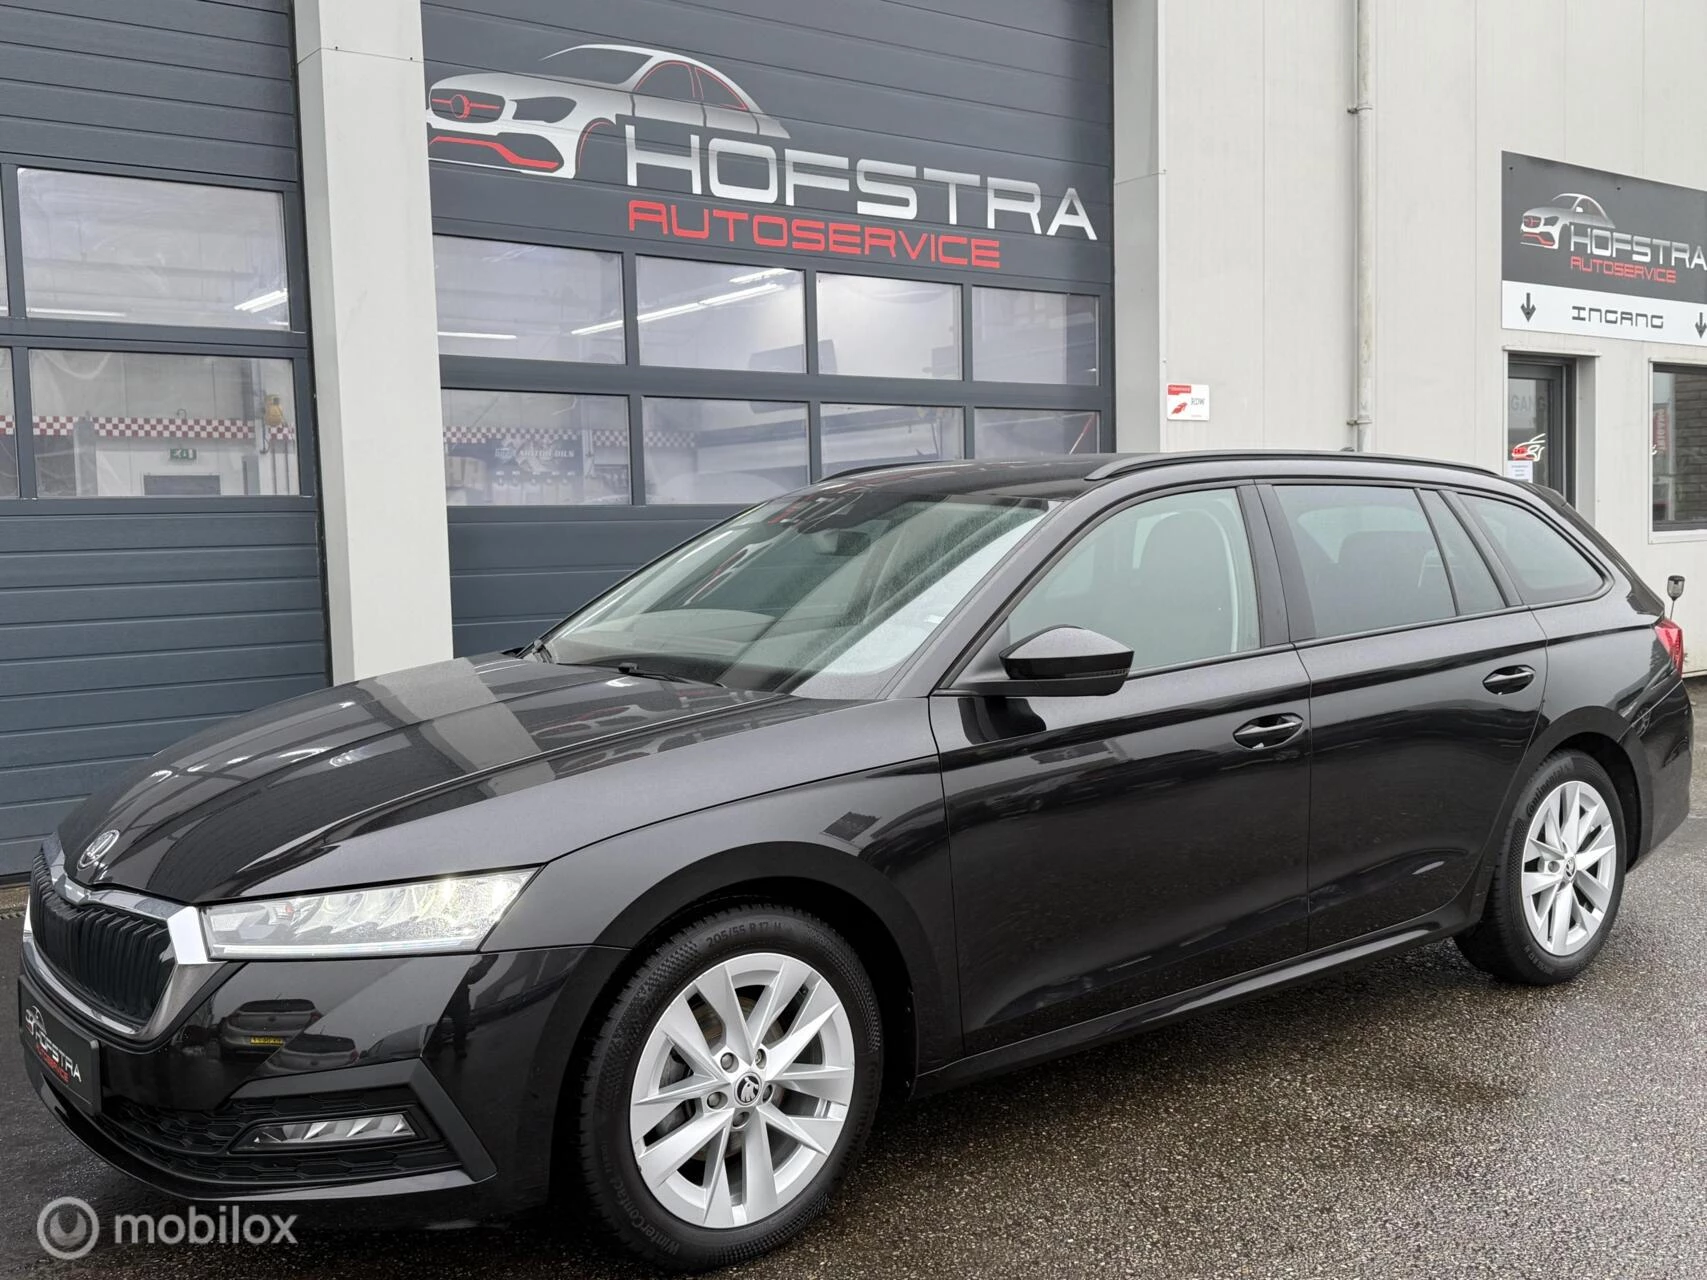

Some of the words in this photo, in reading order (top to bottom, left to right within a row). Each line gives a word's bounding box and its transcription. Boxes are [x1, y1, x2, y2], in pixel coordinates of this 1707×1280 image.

[625, 124, 1098, 241] HOFSTRA
[628, 200, 1000, 269] AUTOSERVICE
[1570, 225, 1707, 271] HOFSTRA
[1570, 255, 1677, 284] AUTOSERVICE
[1571, 305, 1664, 329] INGANG
[705, 924, 746, 948] 205/55
